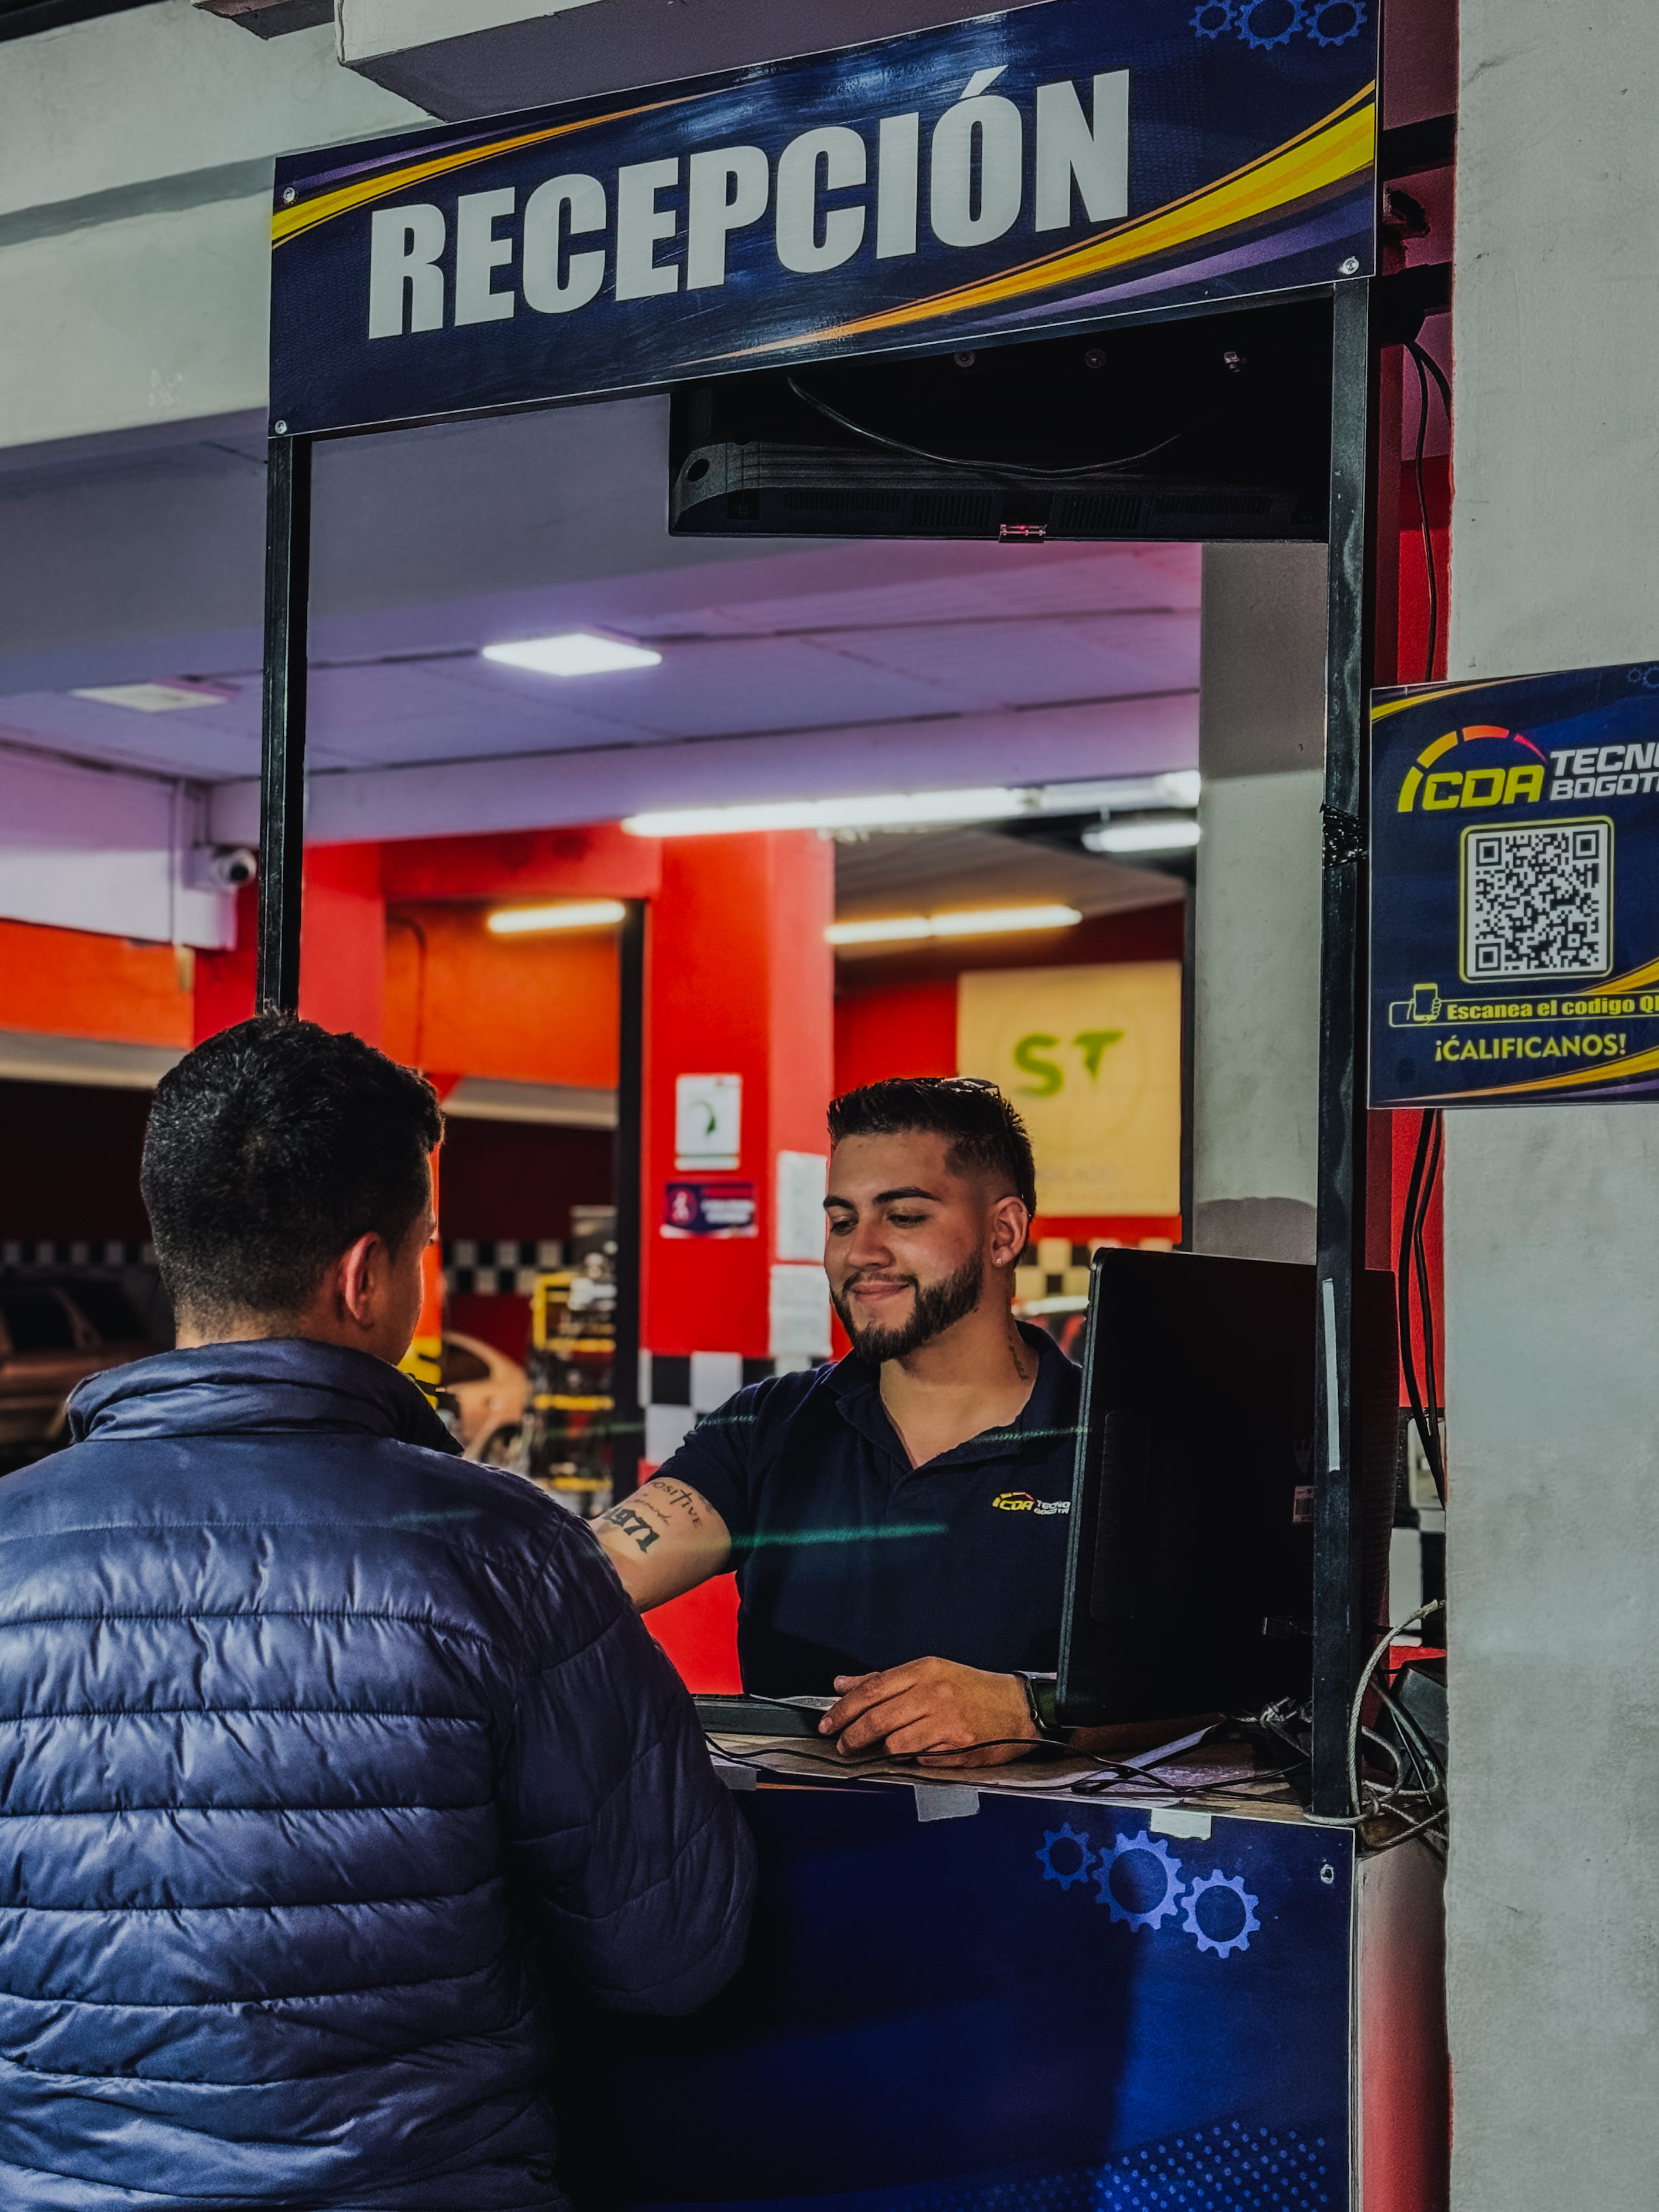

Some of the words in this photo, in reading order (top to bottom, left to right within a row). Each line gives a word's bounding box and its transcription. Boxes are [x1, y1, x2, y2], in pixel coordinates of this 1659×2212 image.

[368, 65, 1130, 340] RECEPCIÓN
[1423, 765, 1544, 810] CDA
[1550, 743, 1659, 776] TECN
[1549, 771, 1659, 802] BOGOT
[1447, 1003, 1533, 1021] Escanea
[1537, 1000, 1557, 1016] el
[1561, 997, 1635, 1015] codigo
[1000, 1500, 1034, 1510] CDA
[1036, 1500, 1071, 1509] TECNO
